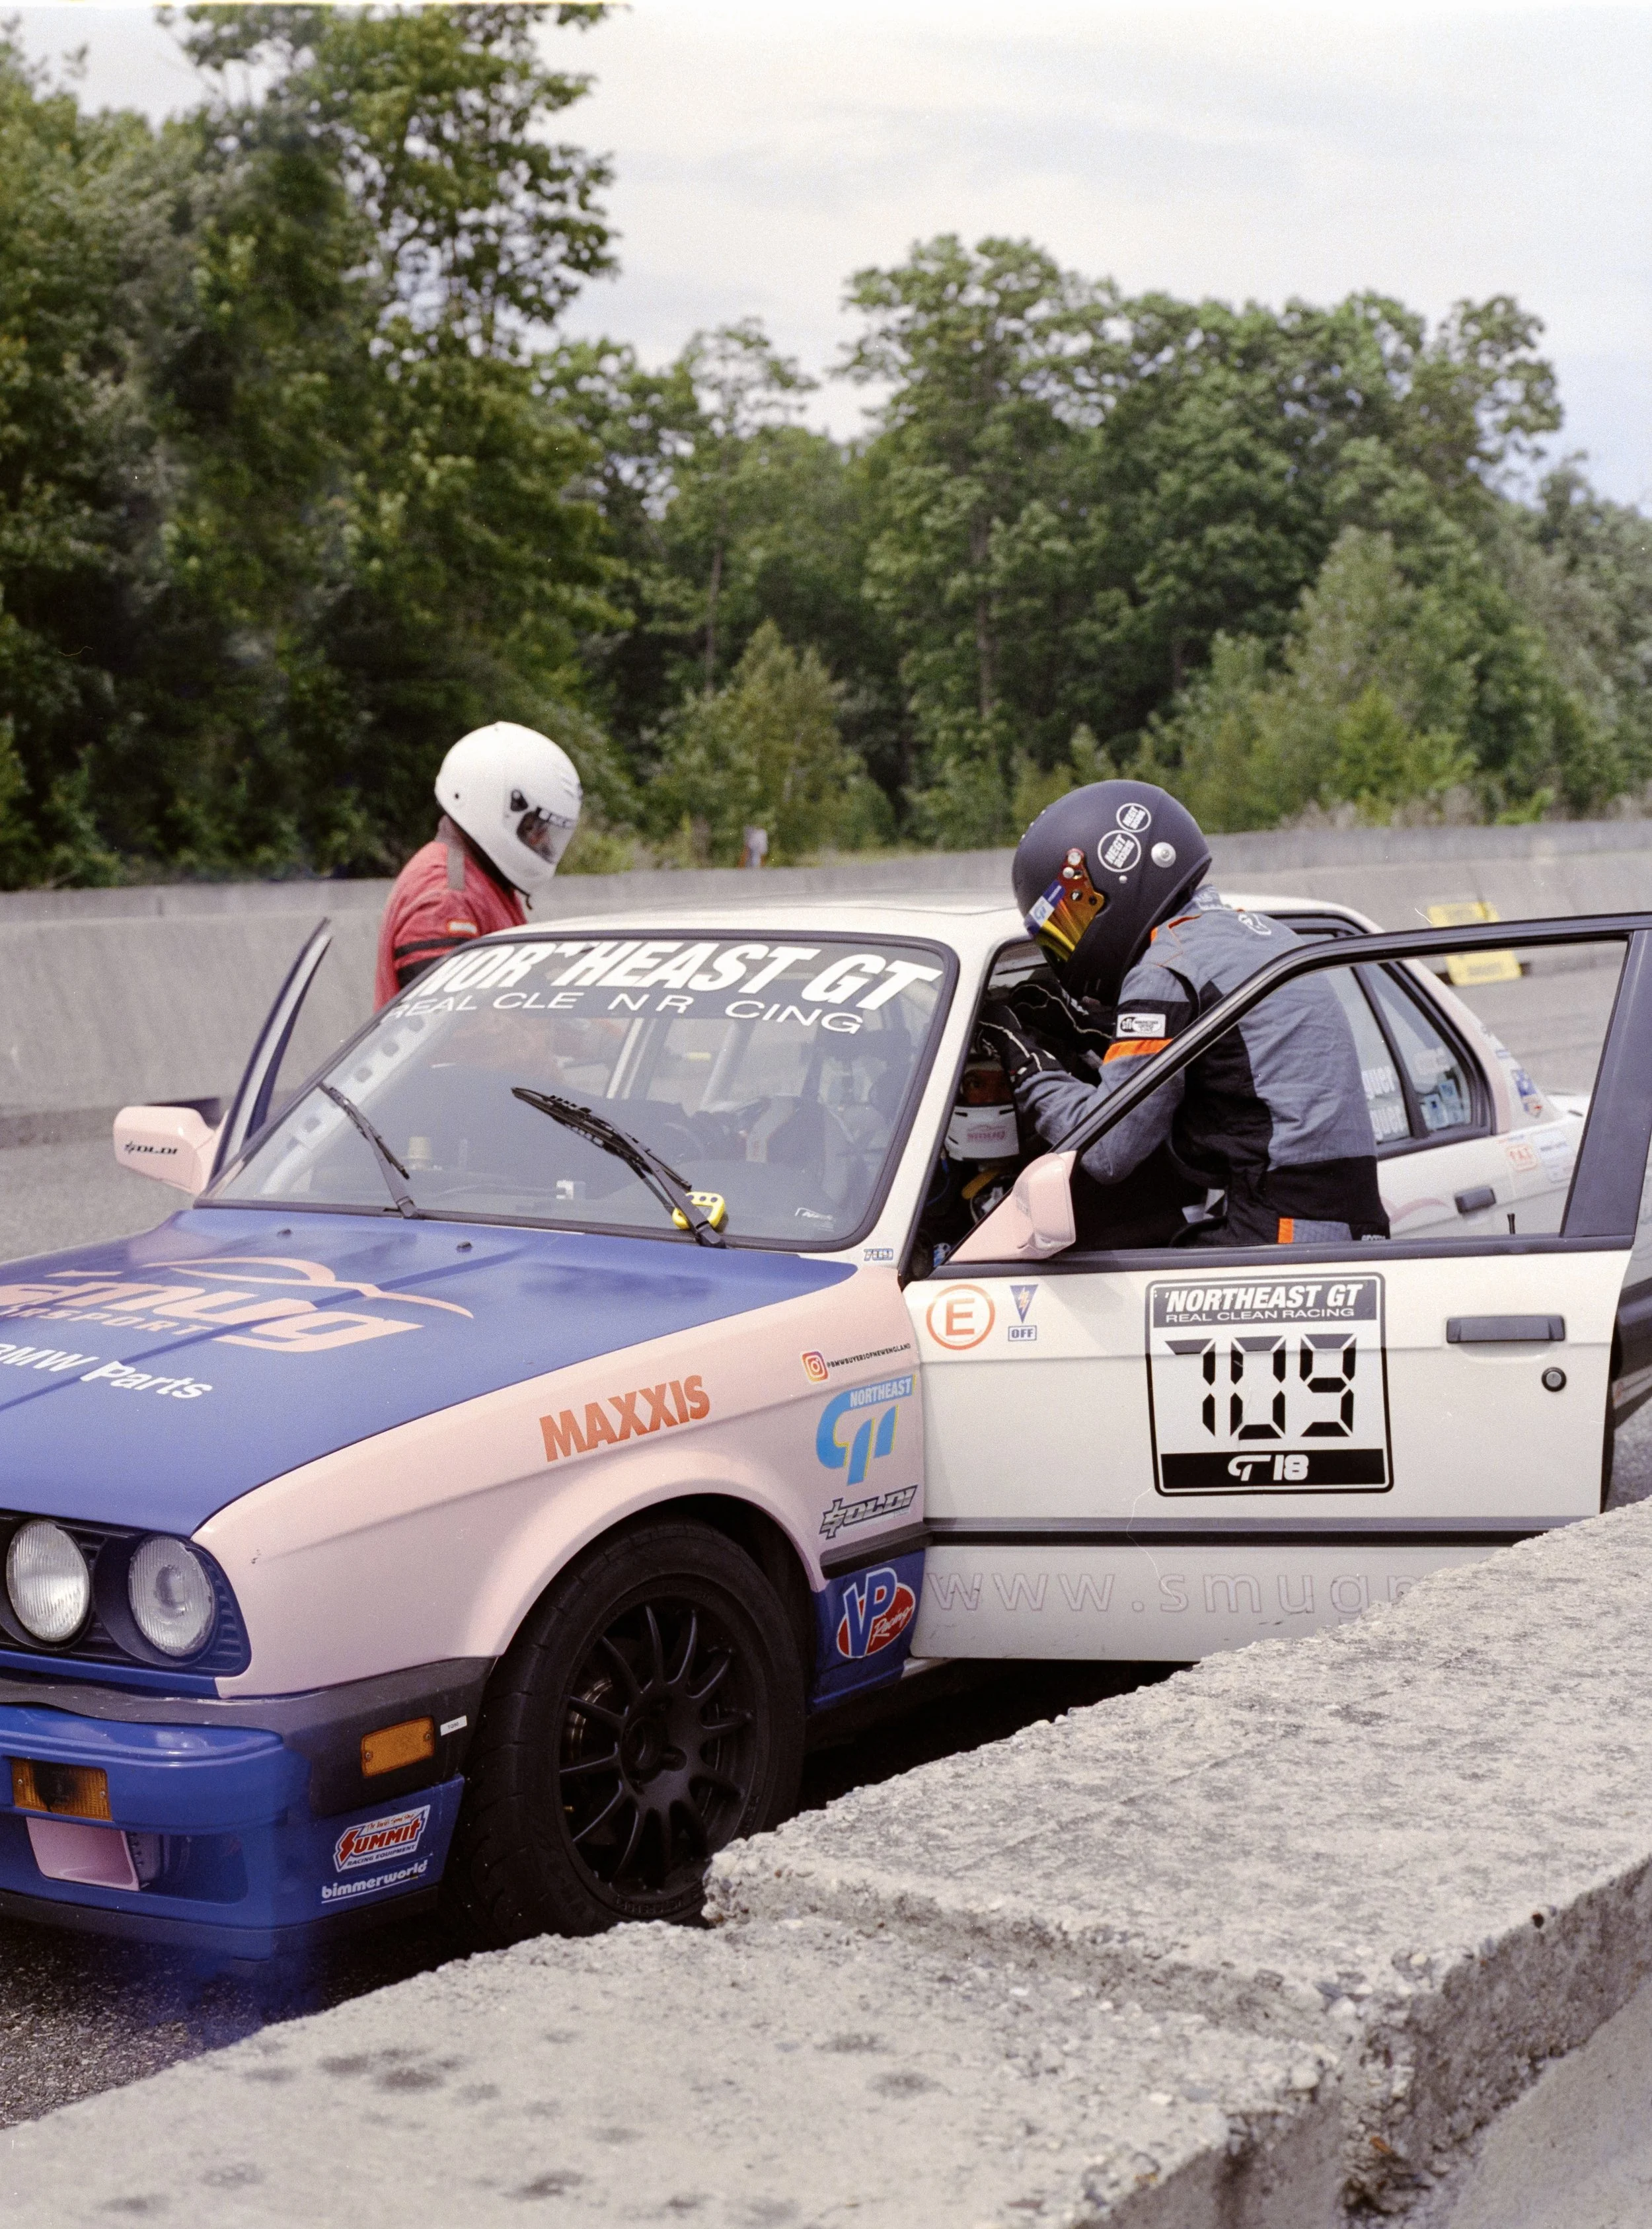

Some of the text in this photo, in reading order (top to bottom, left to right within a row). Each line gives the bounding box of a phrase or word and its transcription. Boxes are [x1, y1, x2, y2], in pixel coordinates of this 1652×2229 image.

[1104, 833, 1126, 864] NEGT
[801, 954, 944, 1010] GT
[492, 992, 650, 1012] CLEN
[946, 1297, 975, 1336] E
[1165, 1308, 1355, 1323] REAL CLEAN RACING
[1166, 1283, 1364, 1313] NORTHEAST GT
[1011, 1328, 1034, 1339] OFF
[80, 1360, 213, 1398] Parts
[850, 1377, 912, 1408] NORTHEAST
[1164, 1332, 1357, 1441] 709
[539, 1374, 711, 1462] MAXXIS
[843, 1567, 898, 1659] VP
[870, 1606, 913, 1647] Racing
[347, 1844, 416, 1867] RACING EQUIPMENT
[321, 1859, 428, 1900] bimmerworld
